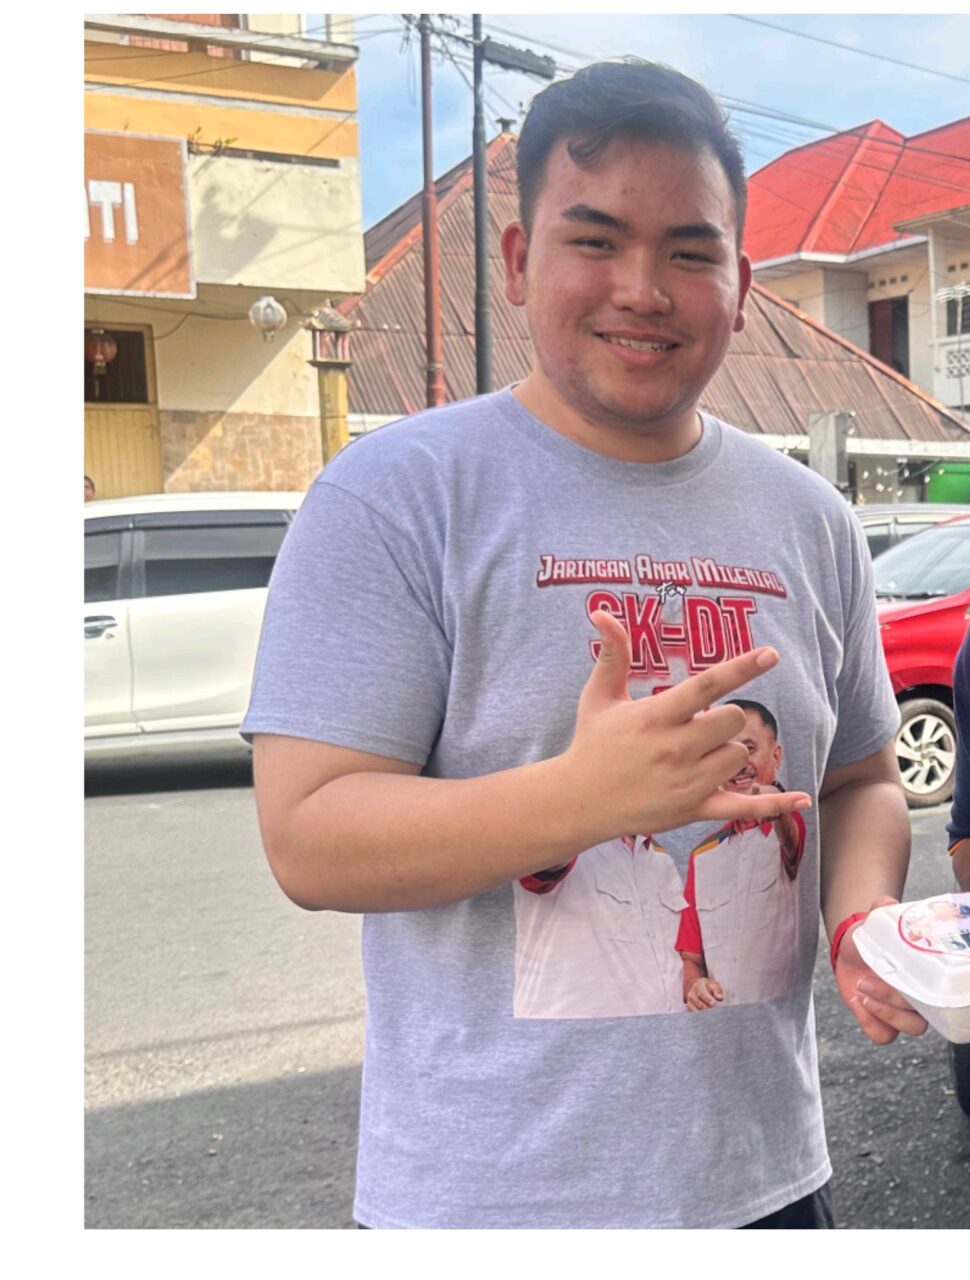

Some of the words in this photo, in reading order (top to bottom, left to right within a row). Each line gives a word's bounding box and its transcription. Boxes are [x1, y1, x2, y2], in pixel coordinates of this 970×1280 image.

[84, 179, 139, 246] TI
[536, 554, 631, 588] JARINGAN
[635, 554, 693, 587] ANAK
[690, 557, 788, 599] MILENIAL
